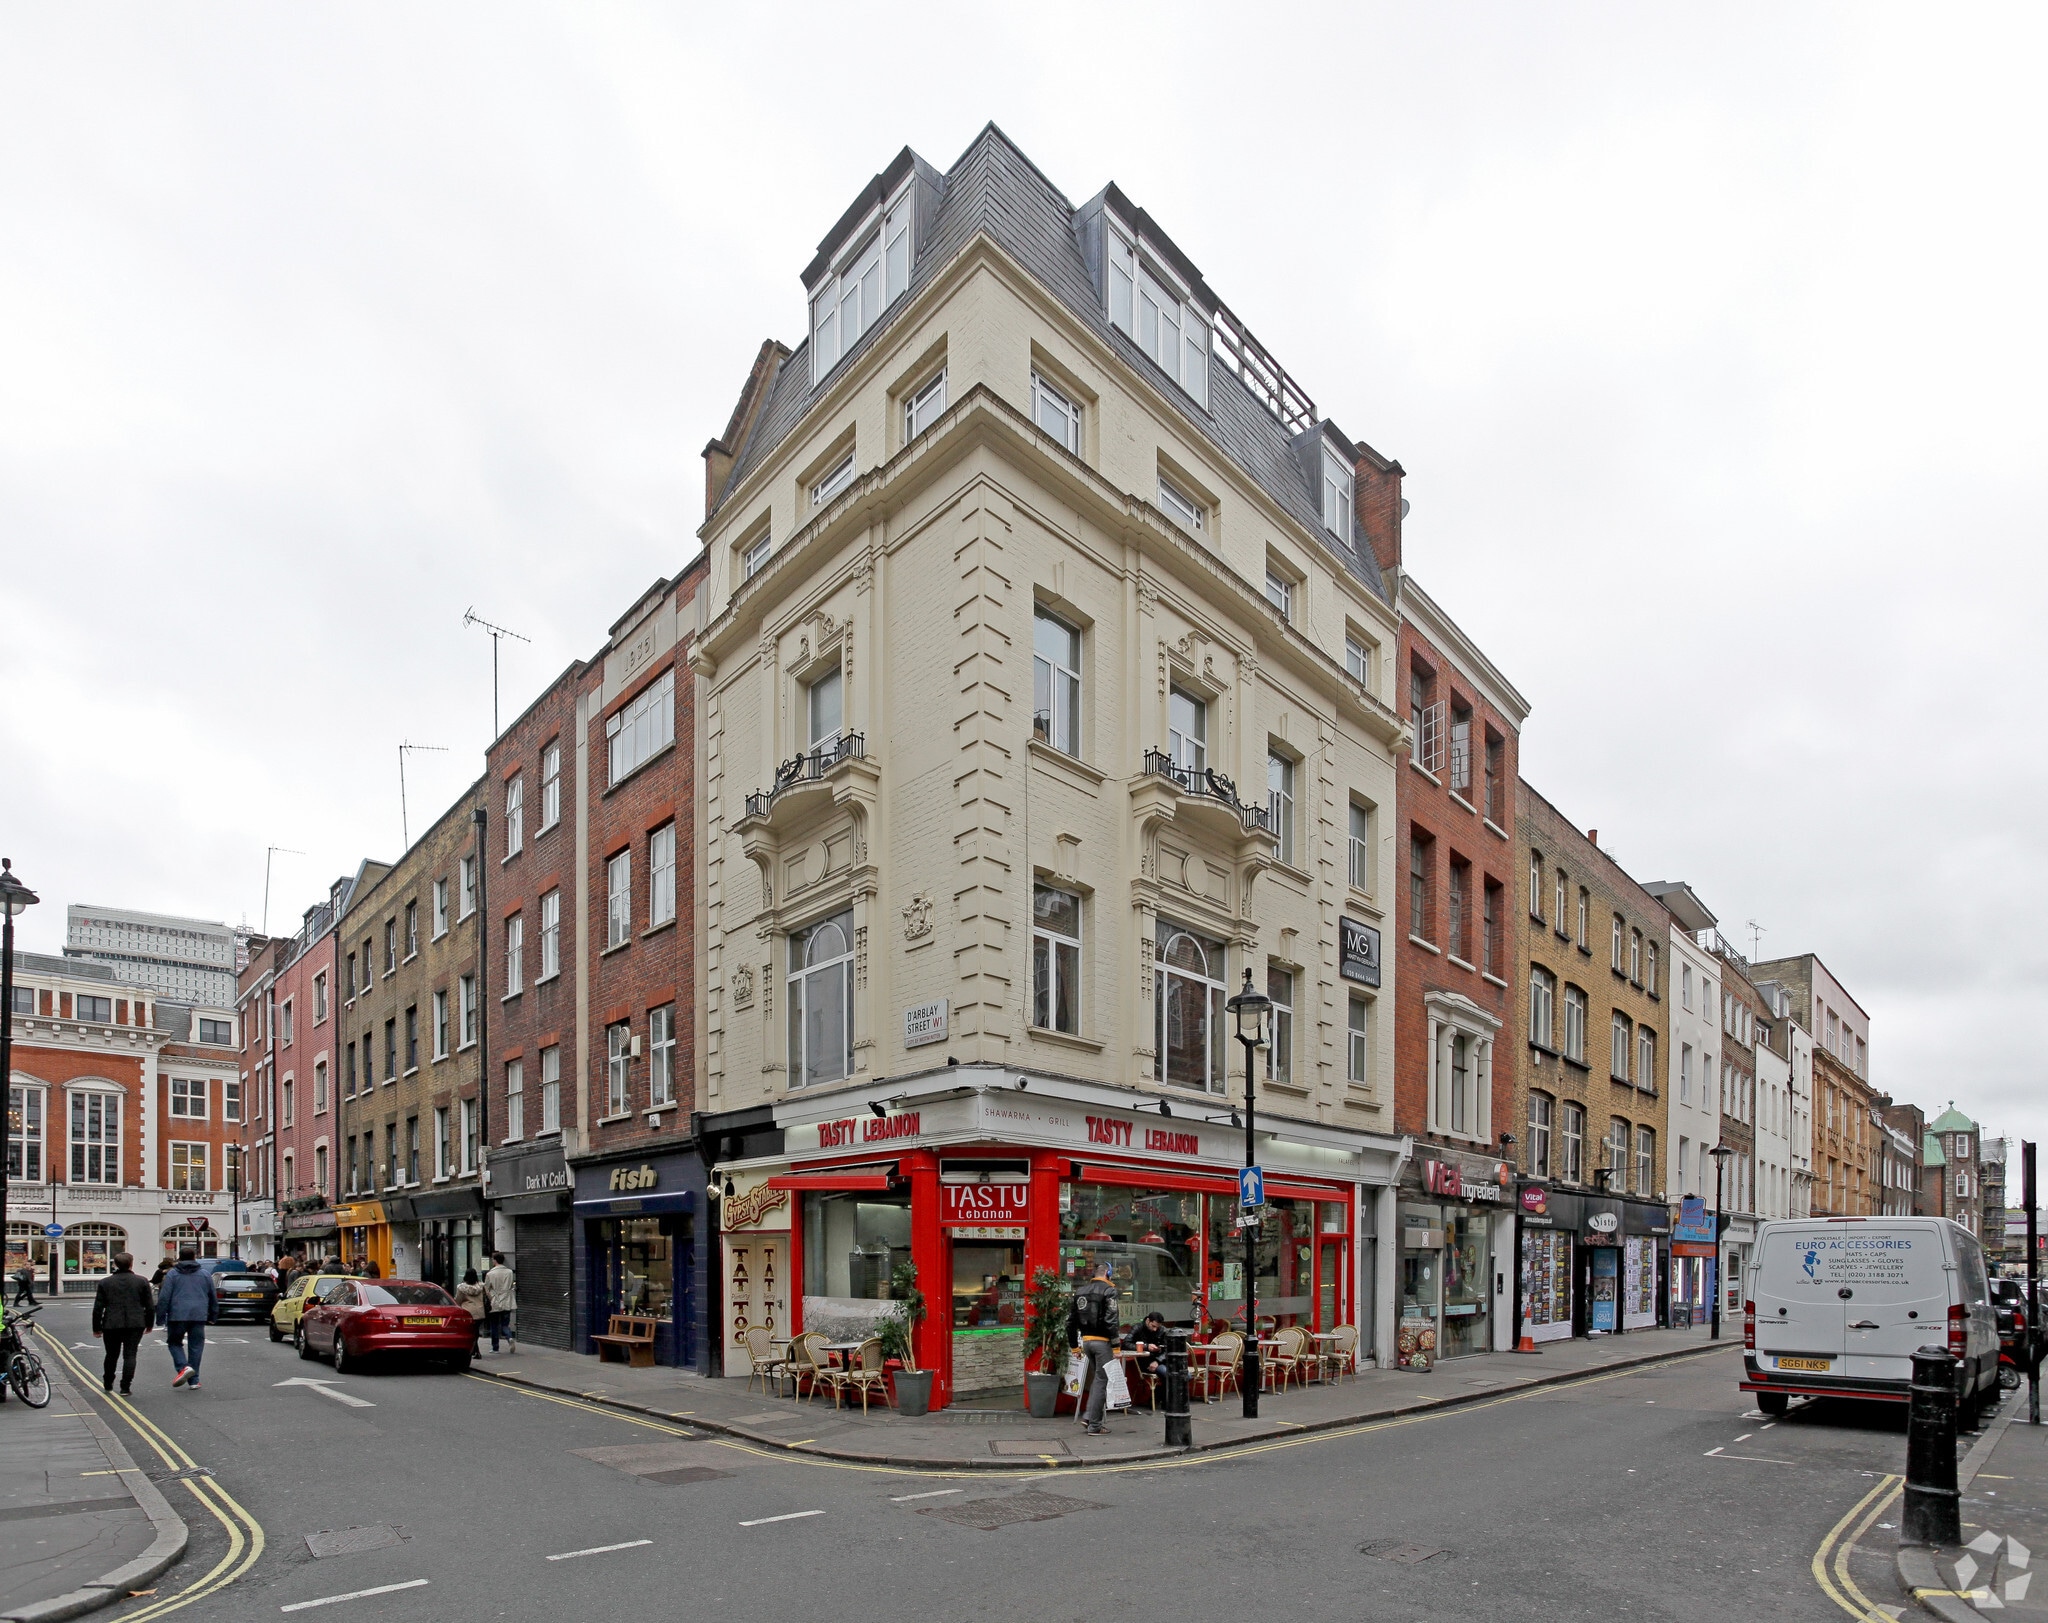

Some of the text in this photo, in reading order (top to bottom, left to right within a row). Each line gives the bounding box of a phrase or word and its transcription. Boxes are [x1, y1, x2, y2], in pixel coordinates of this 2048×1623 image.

[1347, 930, 1369, 955] MG
[907, 1005, 938, 1022] D'ARBLAY
[907, 1017, 942, 1034] STREET W1
[985, 1108, 1070, 1127] SHAWARMA GRILL
[818, 1111, 920, 1148] TASTY LEBANON
[1085, 1116, 1199, 1155] TASTY LEBANON
[526, 1174, 541, 1190] Dark
[549, 1171, 566, 1186] Cold
[1425, 1159, 1461, 1196] Vital
[944, 1185, 1027, 1208] TASTY
[1460, 1178, 1500, 1203] ingredient
[1525, 1193, 1543, 1201] Vital
[958, 1209, 1012, 1219] Lebanon
[1593, 1214, 1617, 1228] Sister
[1795, 1240, 1912, 1250] EURO ACCESSORIES
[1781, 1358, 1826, 1370] SG61 NKS
